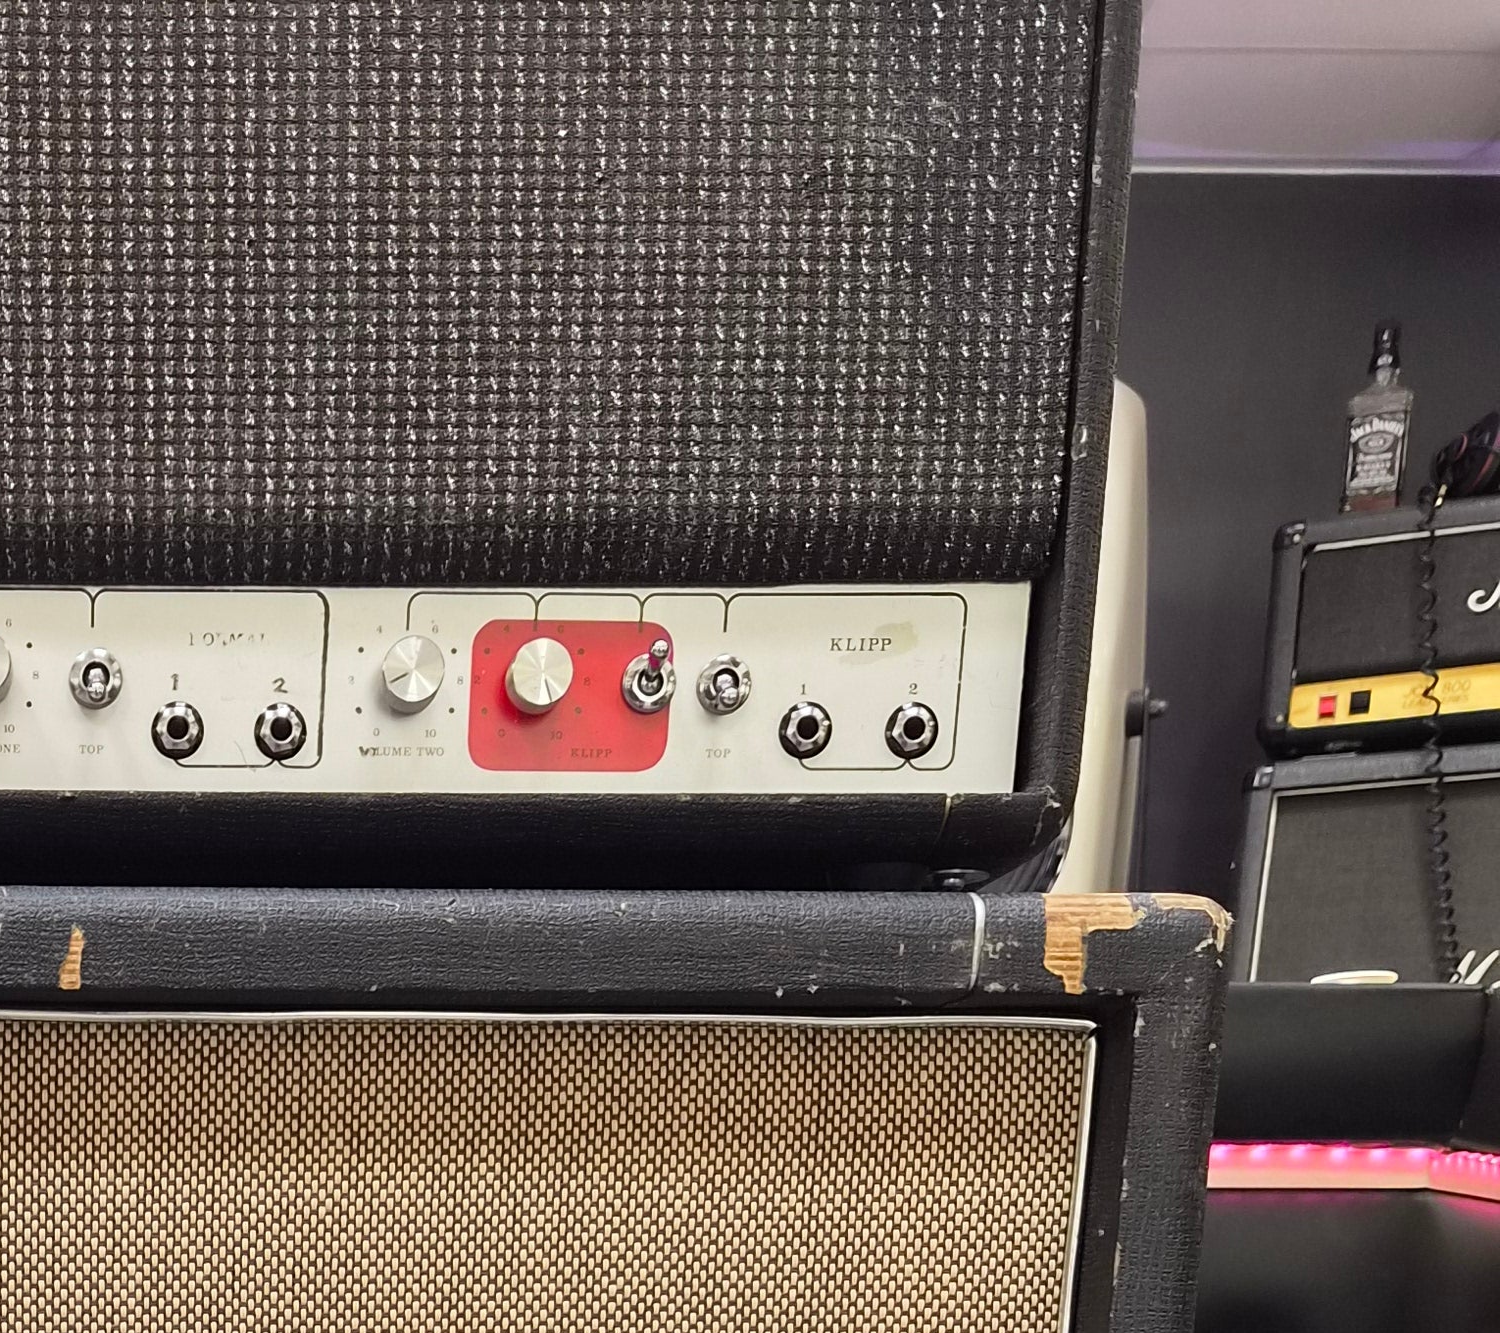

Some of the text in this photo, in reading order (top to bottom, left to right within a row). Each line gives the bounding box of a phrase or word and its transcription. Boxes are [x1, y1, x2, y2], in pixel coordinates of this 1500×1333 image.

[5, 618, 12, 627] 6
[829, 637, 893, 652] KLIPP
[171, 673, 179, 691] 1
[272, 677, 288, 693] 2
[800, 683, 807, 695] 1
[908, 683, 919, 695] 2
[4, 724, 15, 733] 10
[425, 729, 437, 738] 10
[78, 744, 105, 754] TOP
[416, 747, 445, 757] TWO
[570, 748, 613, 759] KLIPP
[705, 748, 731, 758] TOP
